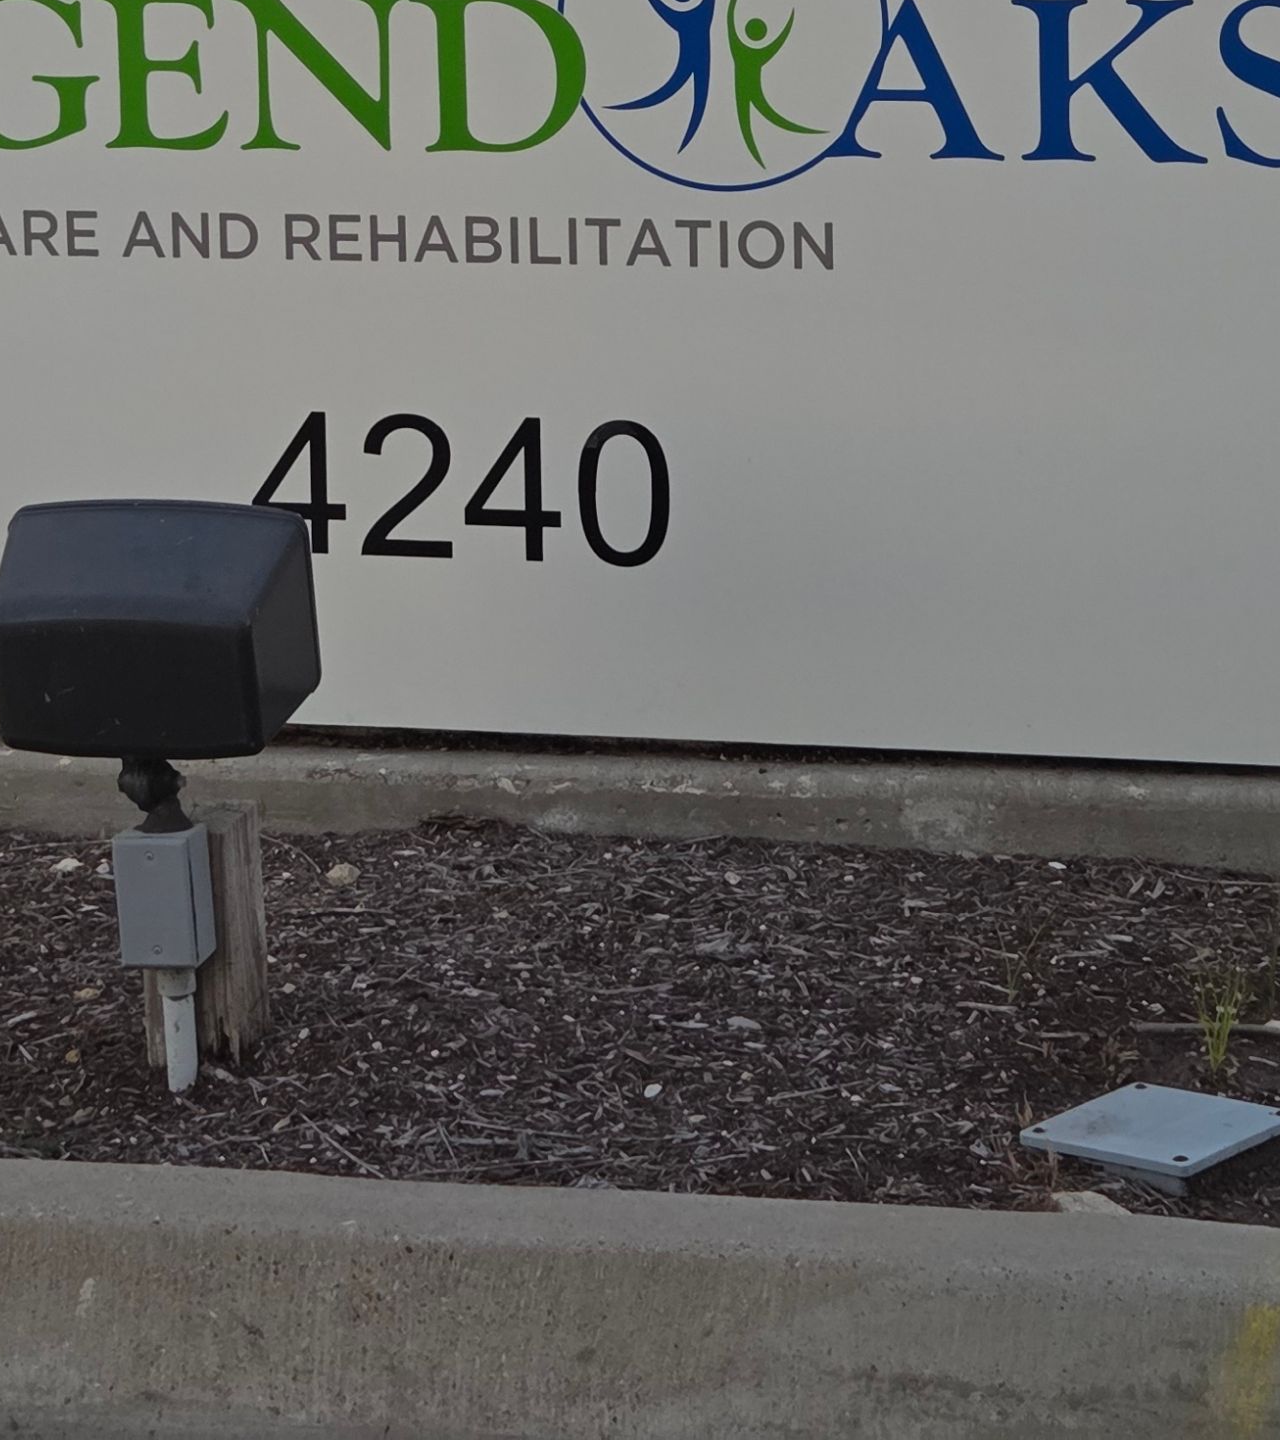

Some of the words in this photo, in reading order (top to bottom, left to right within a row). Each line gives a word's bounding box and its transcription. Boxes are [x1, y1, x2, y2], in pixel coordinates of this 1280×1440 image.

[122, 211, 259, 260] AND
[284, 213, 834, 271] REHABILITATION
[251, 410, 671, 568] 4240
